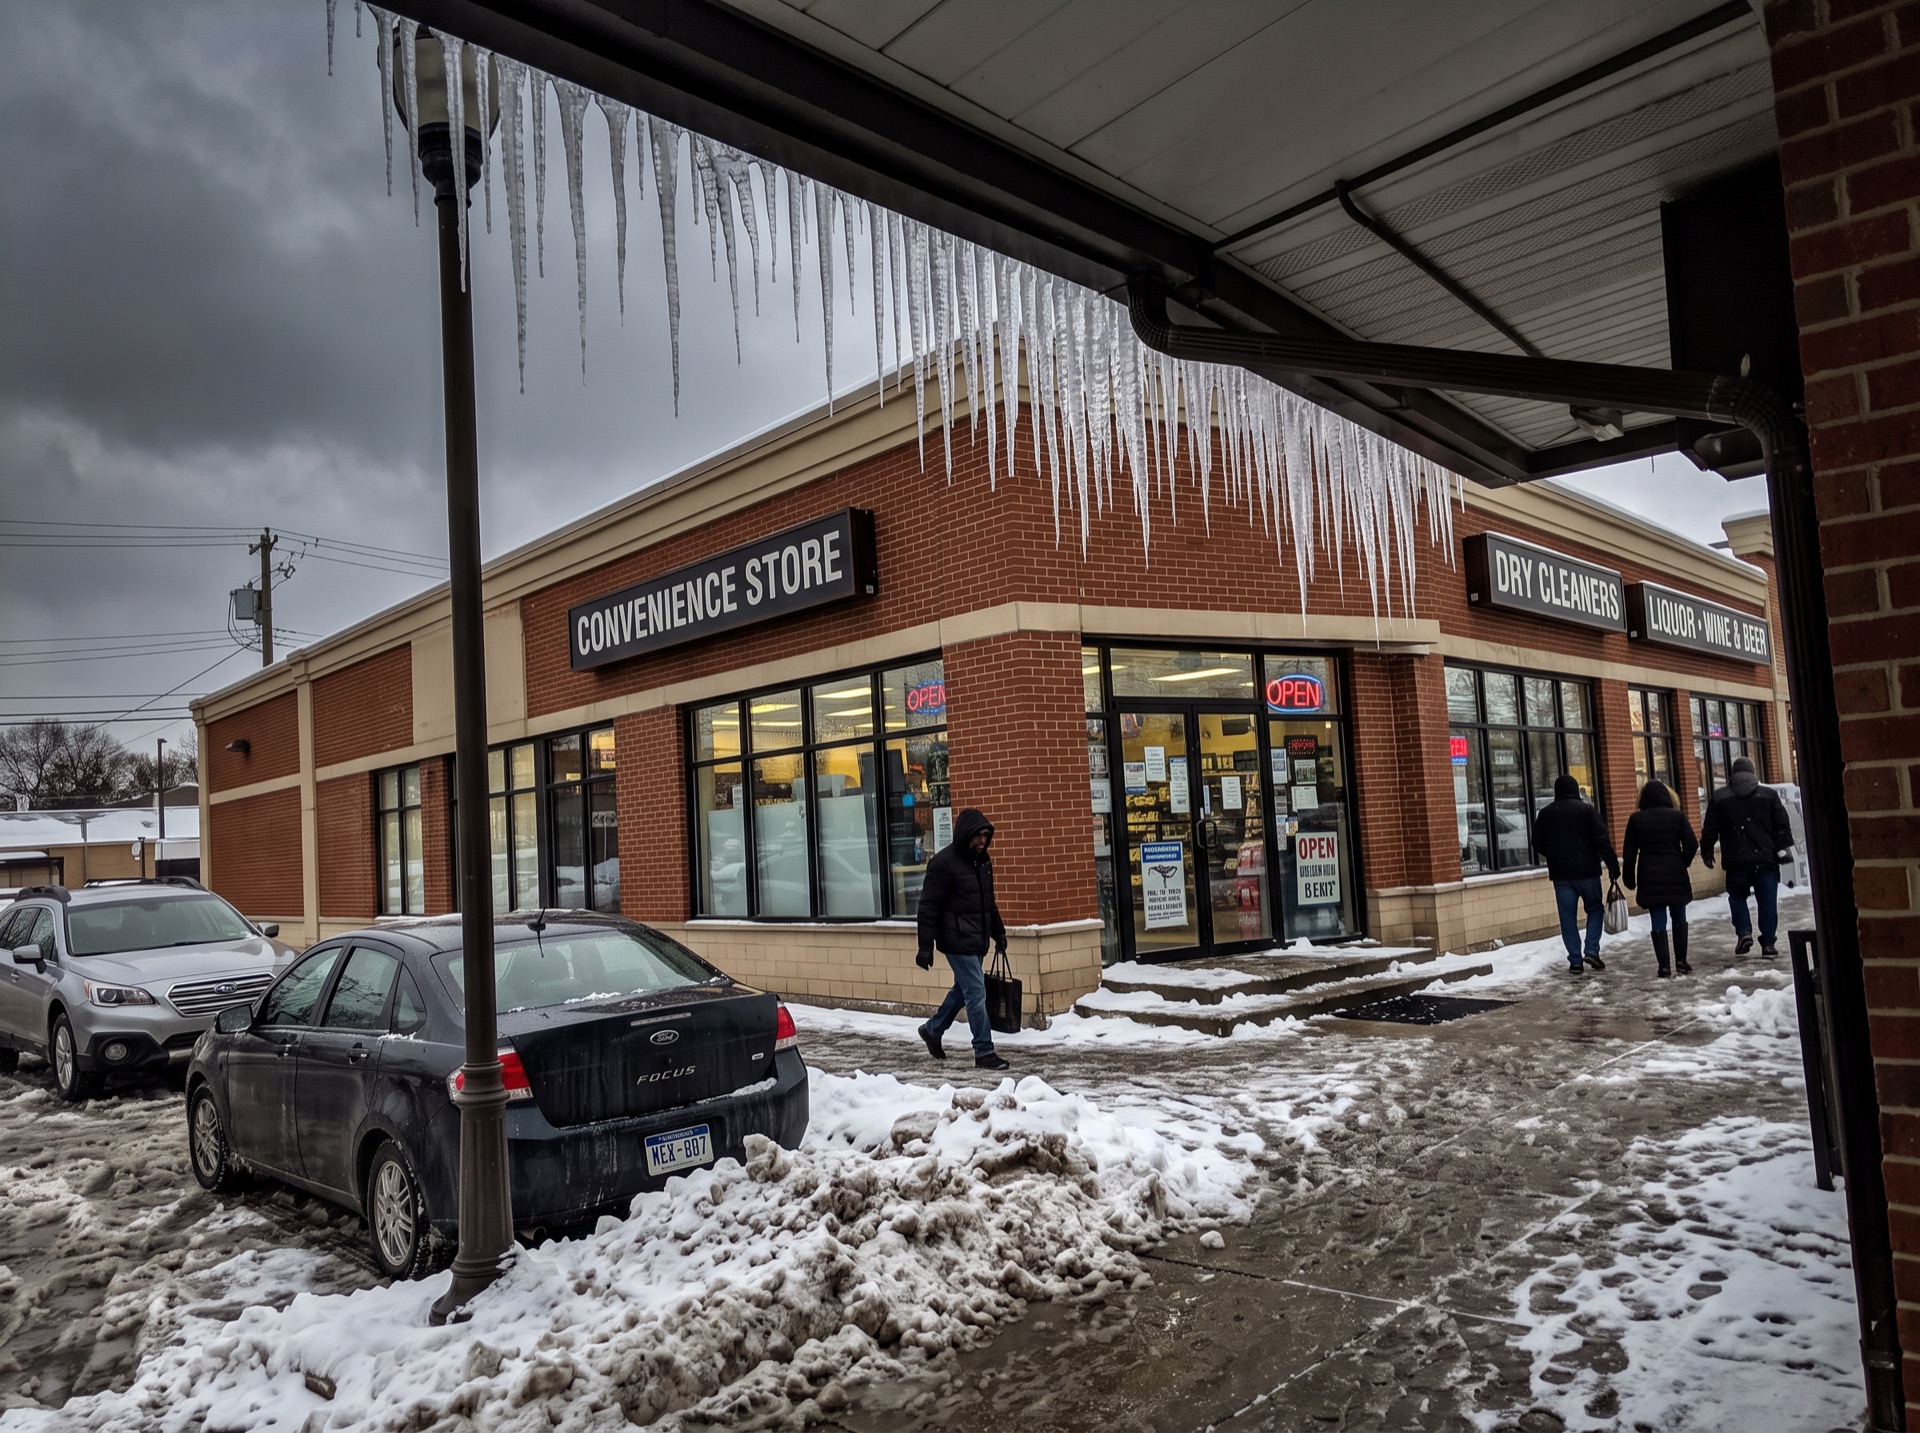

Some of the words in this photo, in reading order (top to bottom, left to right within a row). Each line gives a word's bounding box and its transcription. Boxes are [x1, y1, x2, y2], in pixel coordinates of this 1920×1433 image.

[577, 565, 737, 656] CONVENIENCE
[745, 530, 843, 606] STORE
[1495, 549, 1533, 599] DRY
[1538, 561, 1620, 621] CLEANERS
[1649, 595, 1697, 640] LIQUOR
[1703, 610, 1732, 648] WINE
[1733, 623, 1741, 650] &
[1742, 624, 1768, 656] BEER
[907, 685, 946, 711] OPEN
[1266, 679, 1321, 707] OPEN
[1298, 836, 1335, 860] OPEN
[637, 1065, 696, 1085] FOCUS
